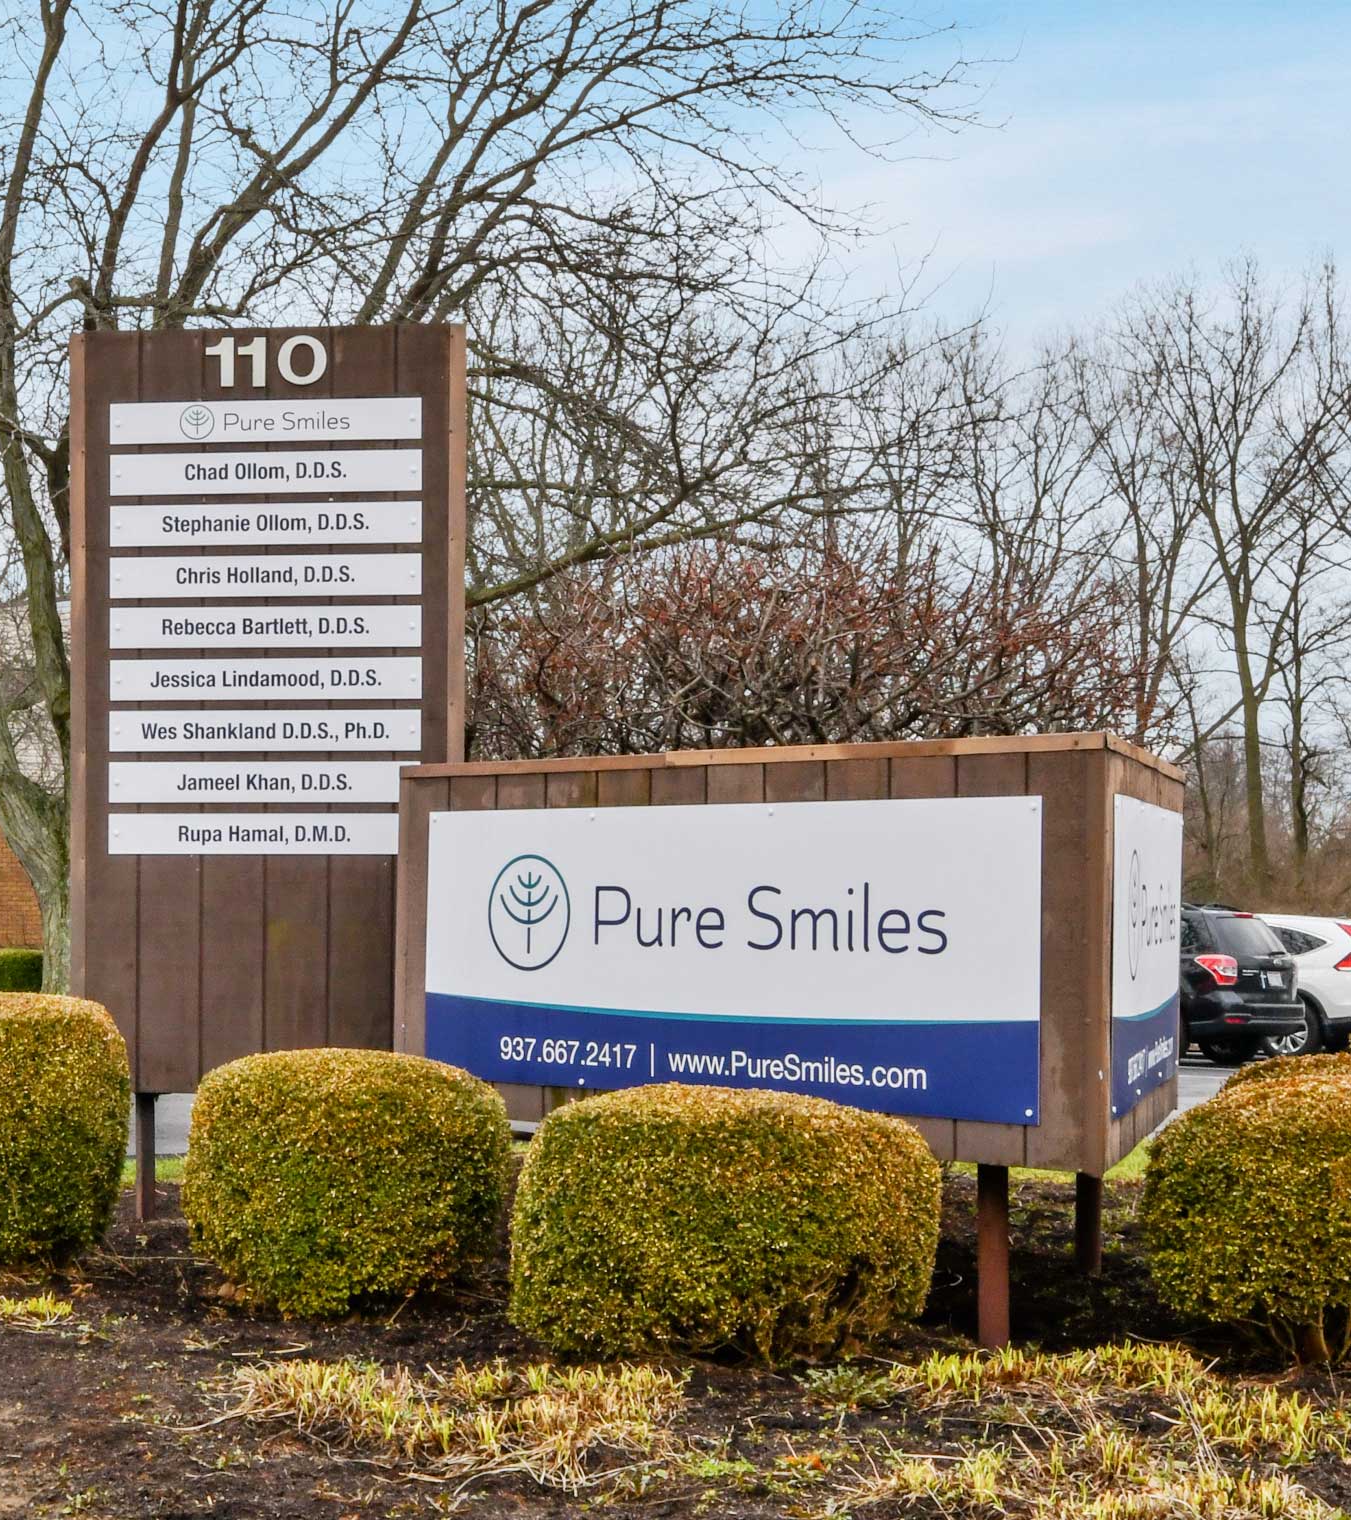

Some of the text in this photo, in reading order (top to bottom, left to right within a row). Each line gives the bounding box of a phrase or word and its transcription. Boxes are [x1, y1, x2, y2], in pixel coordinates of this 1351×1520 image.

[204, 334, 328, 388] 110
[223, 410, 351, 432] Pure Smiles
[184, 461, 347, 482] Chad Ollom, D.D.S.
[162, 513, 370, 536] Stephanie Ollom, D.D.S.
[176, 565, 355, 586] Chris Holland, D.D.S.
[162, 617, 370, 638] Rebecca Bartlett, D.D.S.
[150, 669, 382, 690] Jessica Lindamood, D.D.S.
[141, 722, 390, 742] Wes Shankland D.D.S., Ph.D.
[177, 773, 352, 793] Jameel Khan, D.D.S.
[178, 825, 351, 846] Rupa Hamal, D.M.D.
[594, 881, 948, 955] Pure Smiles
[500, 1036, 928, 1091] 937.667.2417 www.PureSmiles.com
